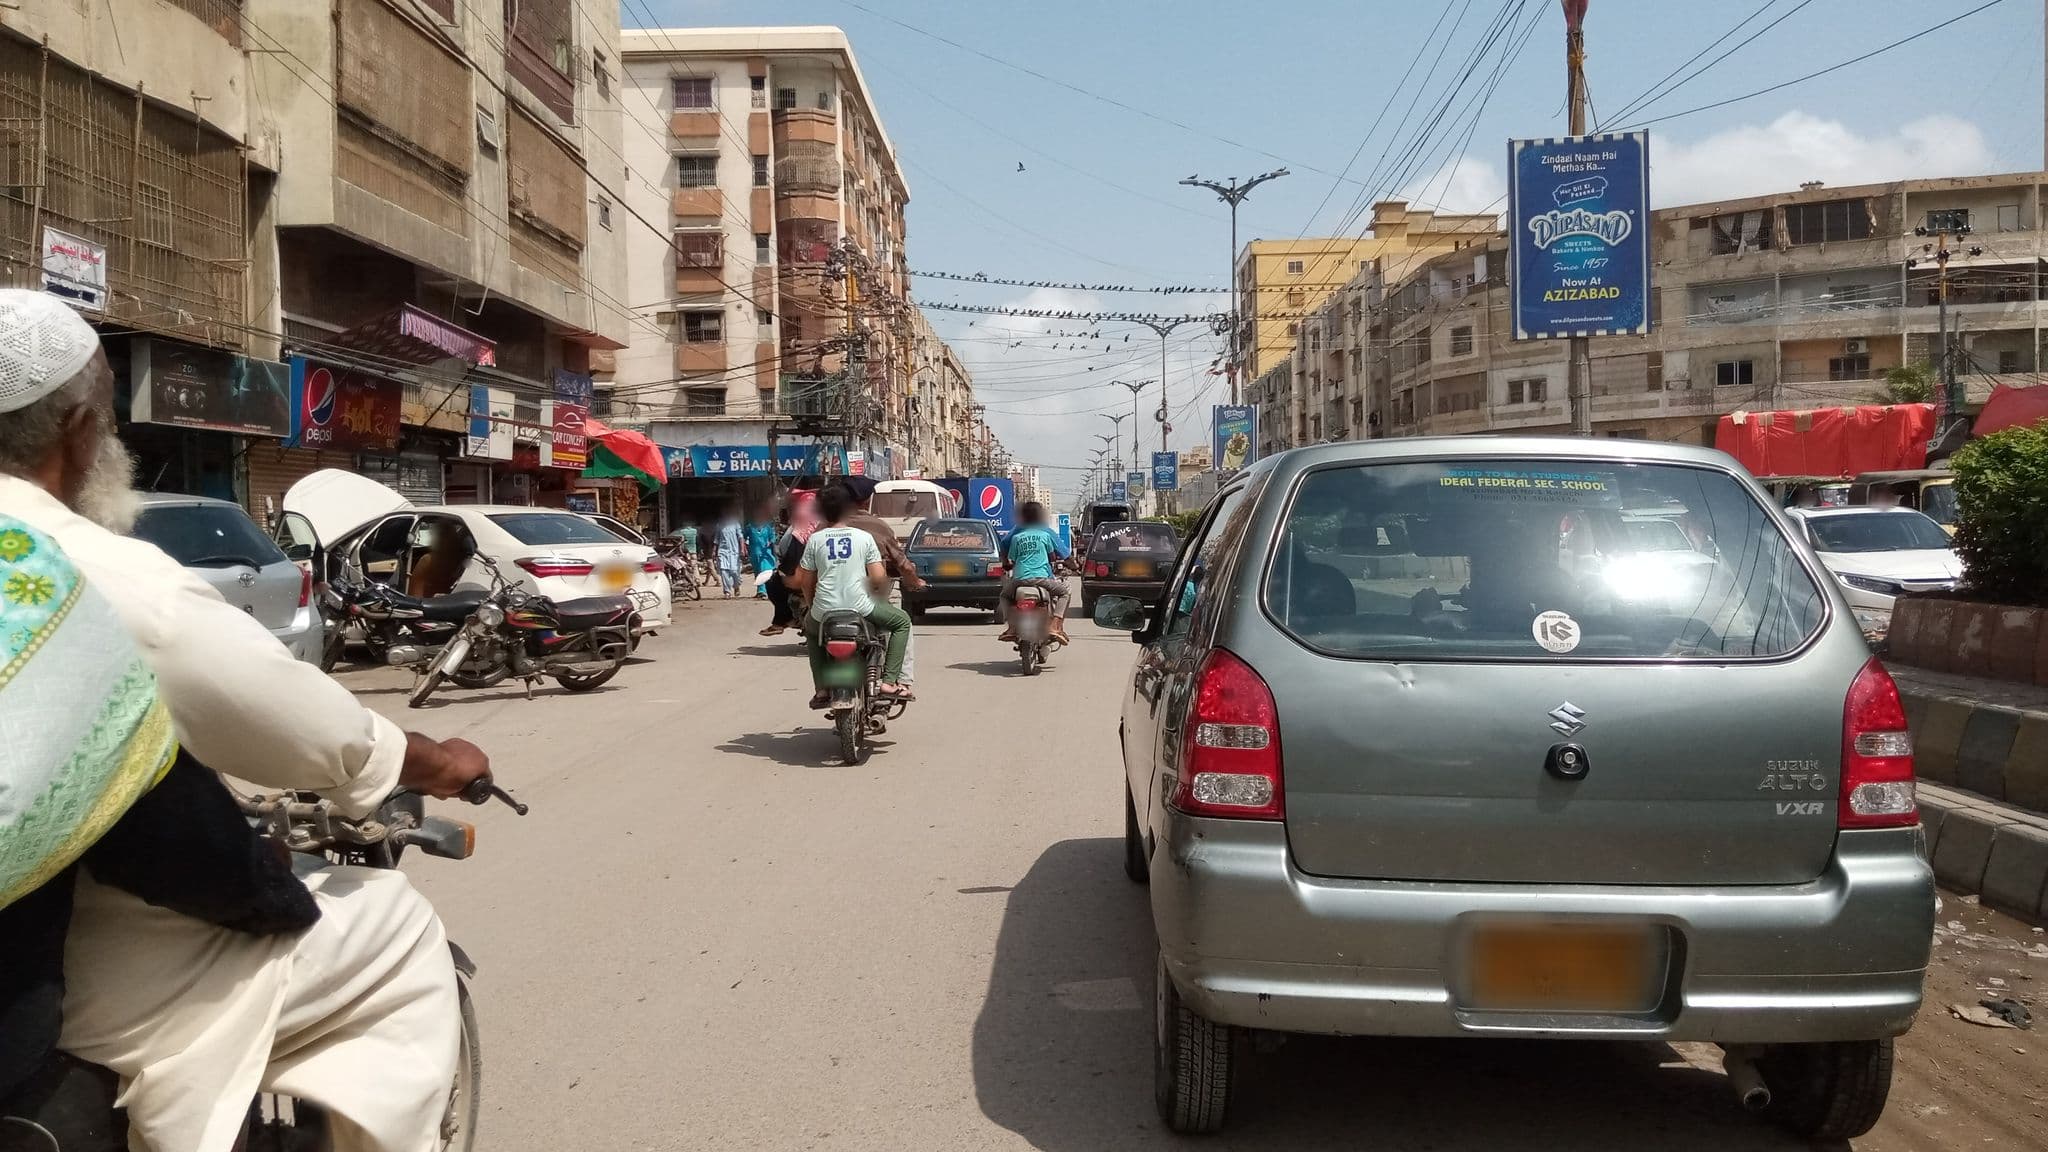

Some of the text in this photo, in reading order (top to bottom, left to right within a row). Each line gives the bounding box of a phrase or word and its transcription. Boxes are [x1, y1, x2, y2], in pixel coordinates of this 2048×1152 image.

[1541, 150, 1617, 165] Zindagi Naam Hai
[1553, 258, 1609, 273] Since 1957
[1562, 277, 1602, 288] Now At
[1543, 287, 1620, 302] AZIZABAD
[306, 427, 333, 443] pepsi
[730, 450, 749, 459] Cafe
[1440, 477, 1608, 491] IDEAL FEDERAL SEC. SCHOOL
[826, 537, 853, 560] 13
[1758, 774, 1827, 791] ALTO
[1776, 802, 1824, 815] VXR
